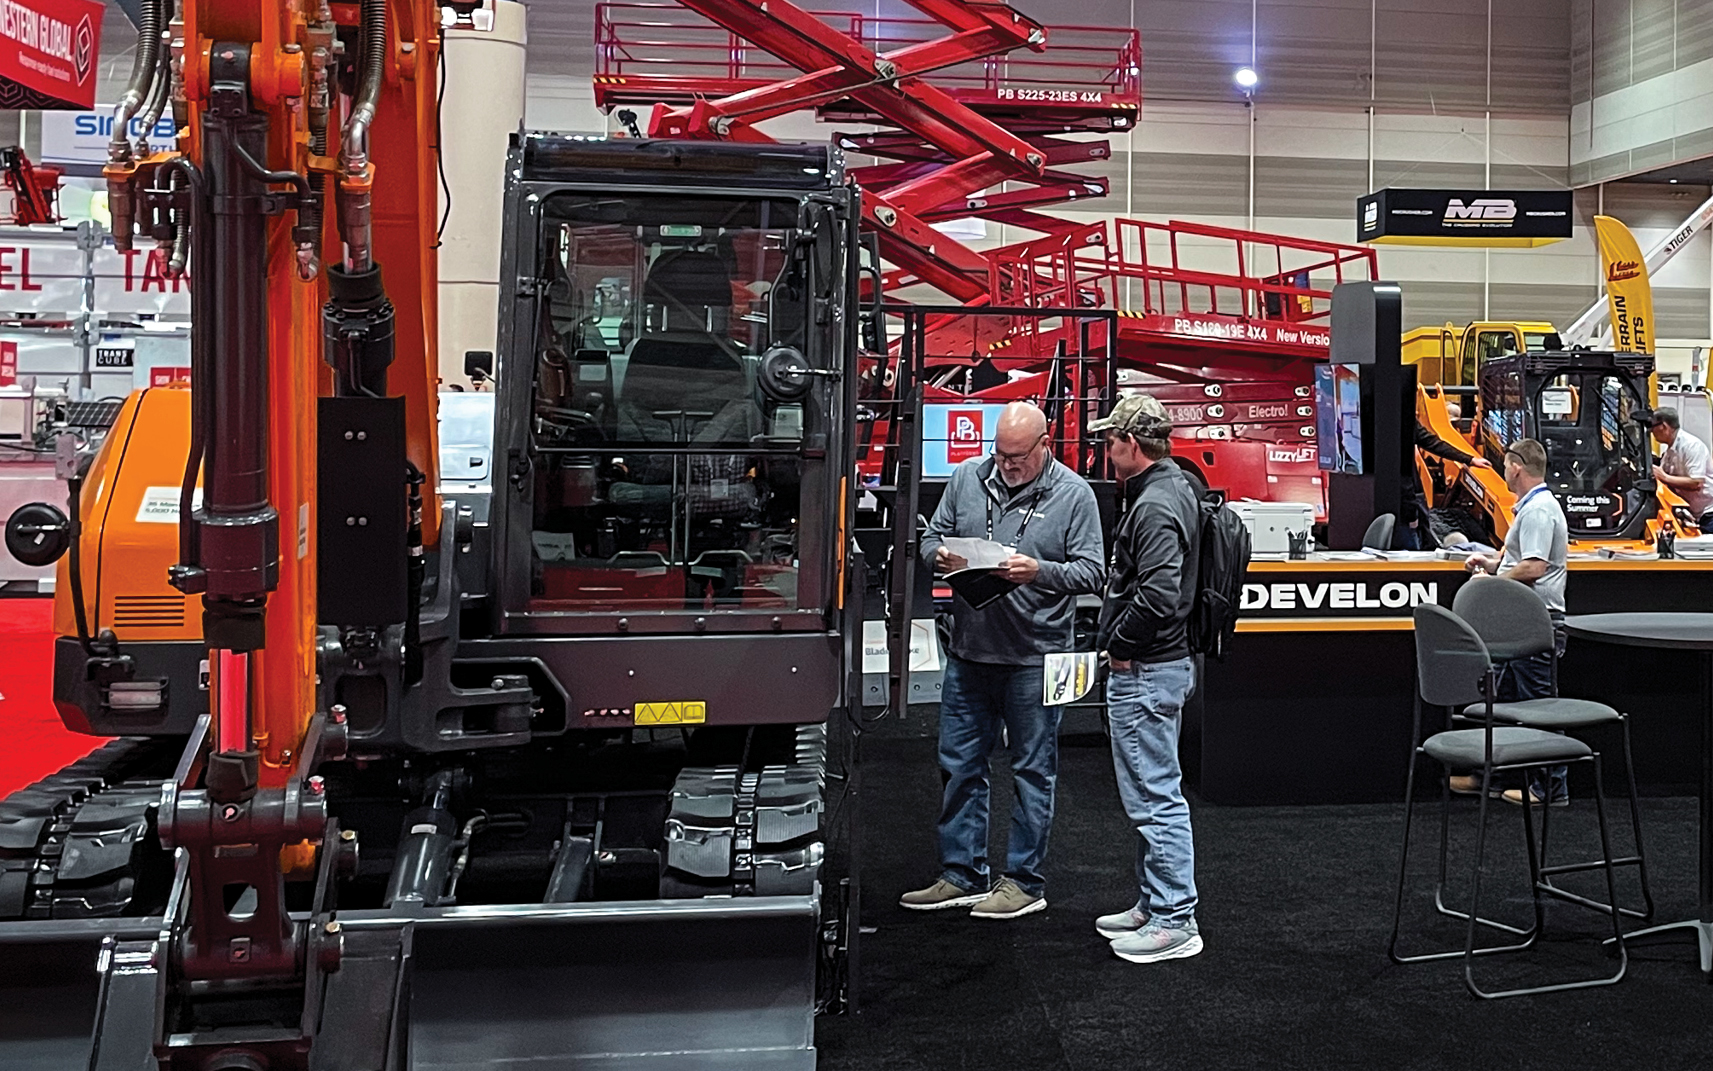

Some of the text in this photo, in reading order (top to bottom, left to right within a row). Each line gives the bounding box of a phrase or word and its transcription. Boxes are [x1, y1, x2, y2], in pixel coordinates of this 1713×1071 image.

[40, 14, 72, 61] GLOBAL
[998, 89, 1102, 102] PB S225-23ES 4X4
[1444, 199, 1517, 218] MB
[1670, 225, 1694, 250] TIGER
[1175, 319, 1190, 332] PB
[1247, 325, 1268, 341] 4X4
[1276, 328, 1297, 343] New
[1566, 495, 1611, 506] Coming this
[1566, 504, 1599, 512] Summer
[1239, 582, 1438, 609] DEVELON
